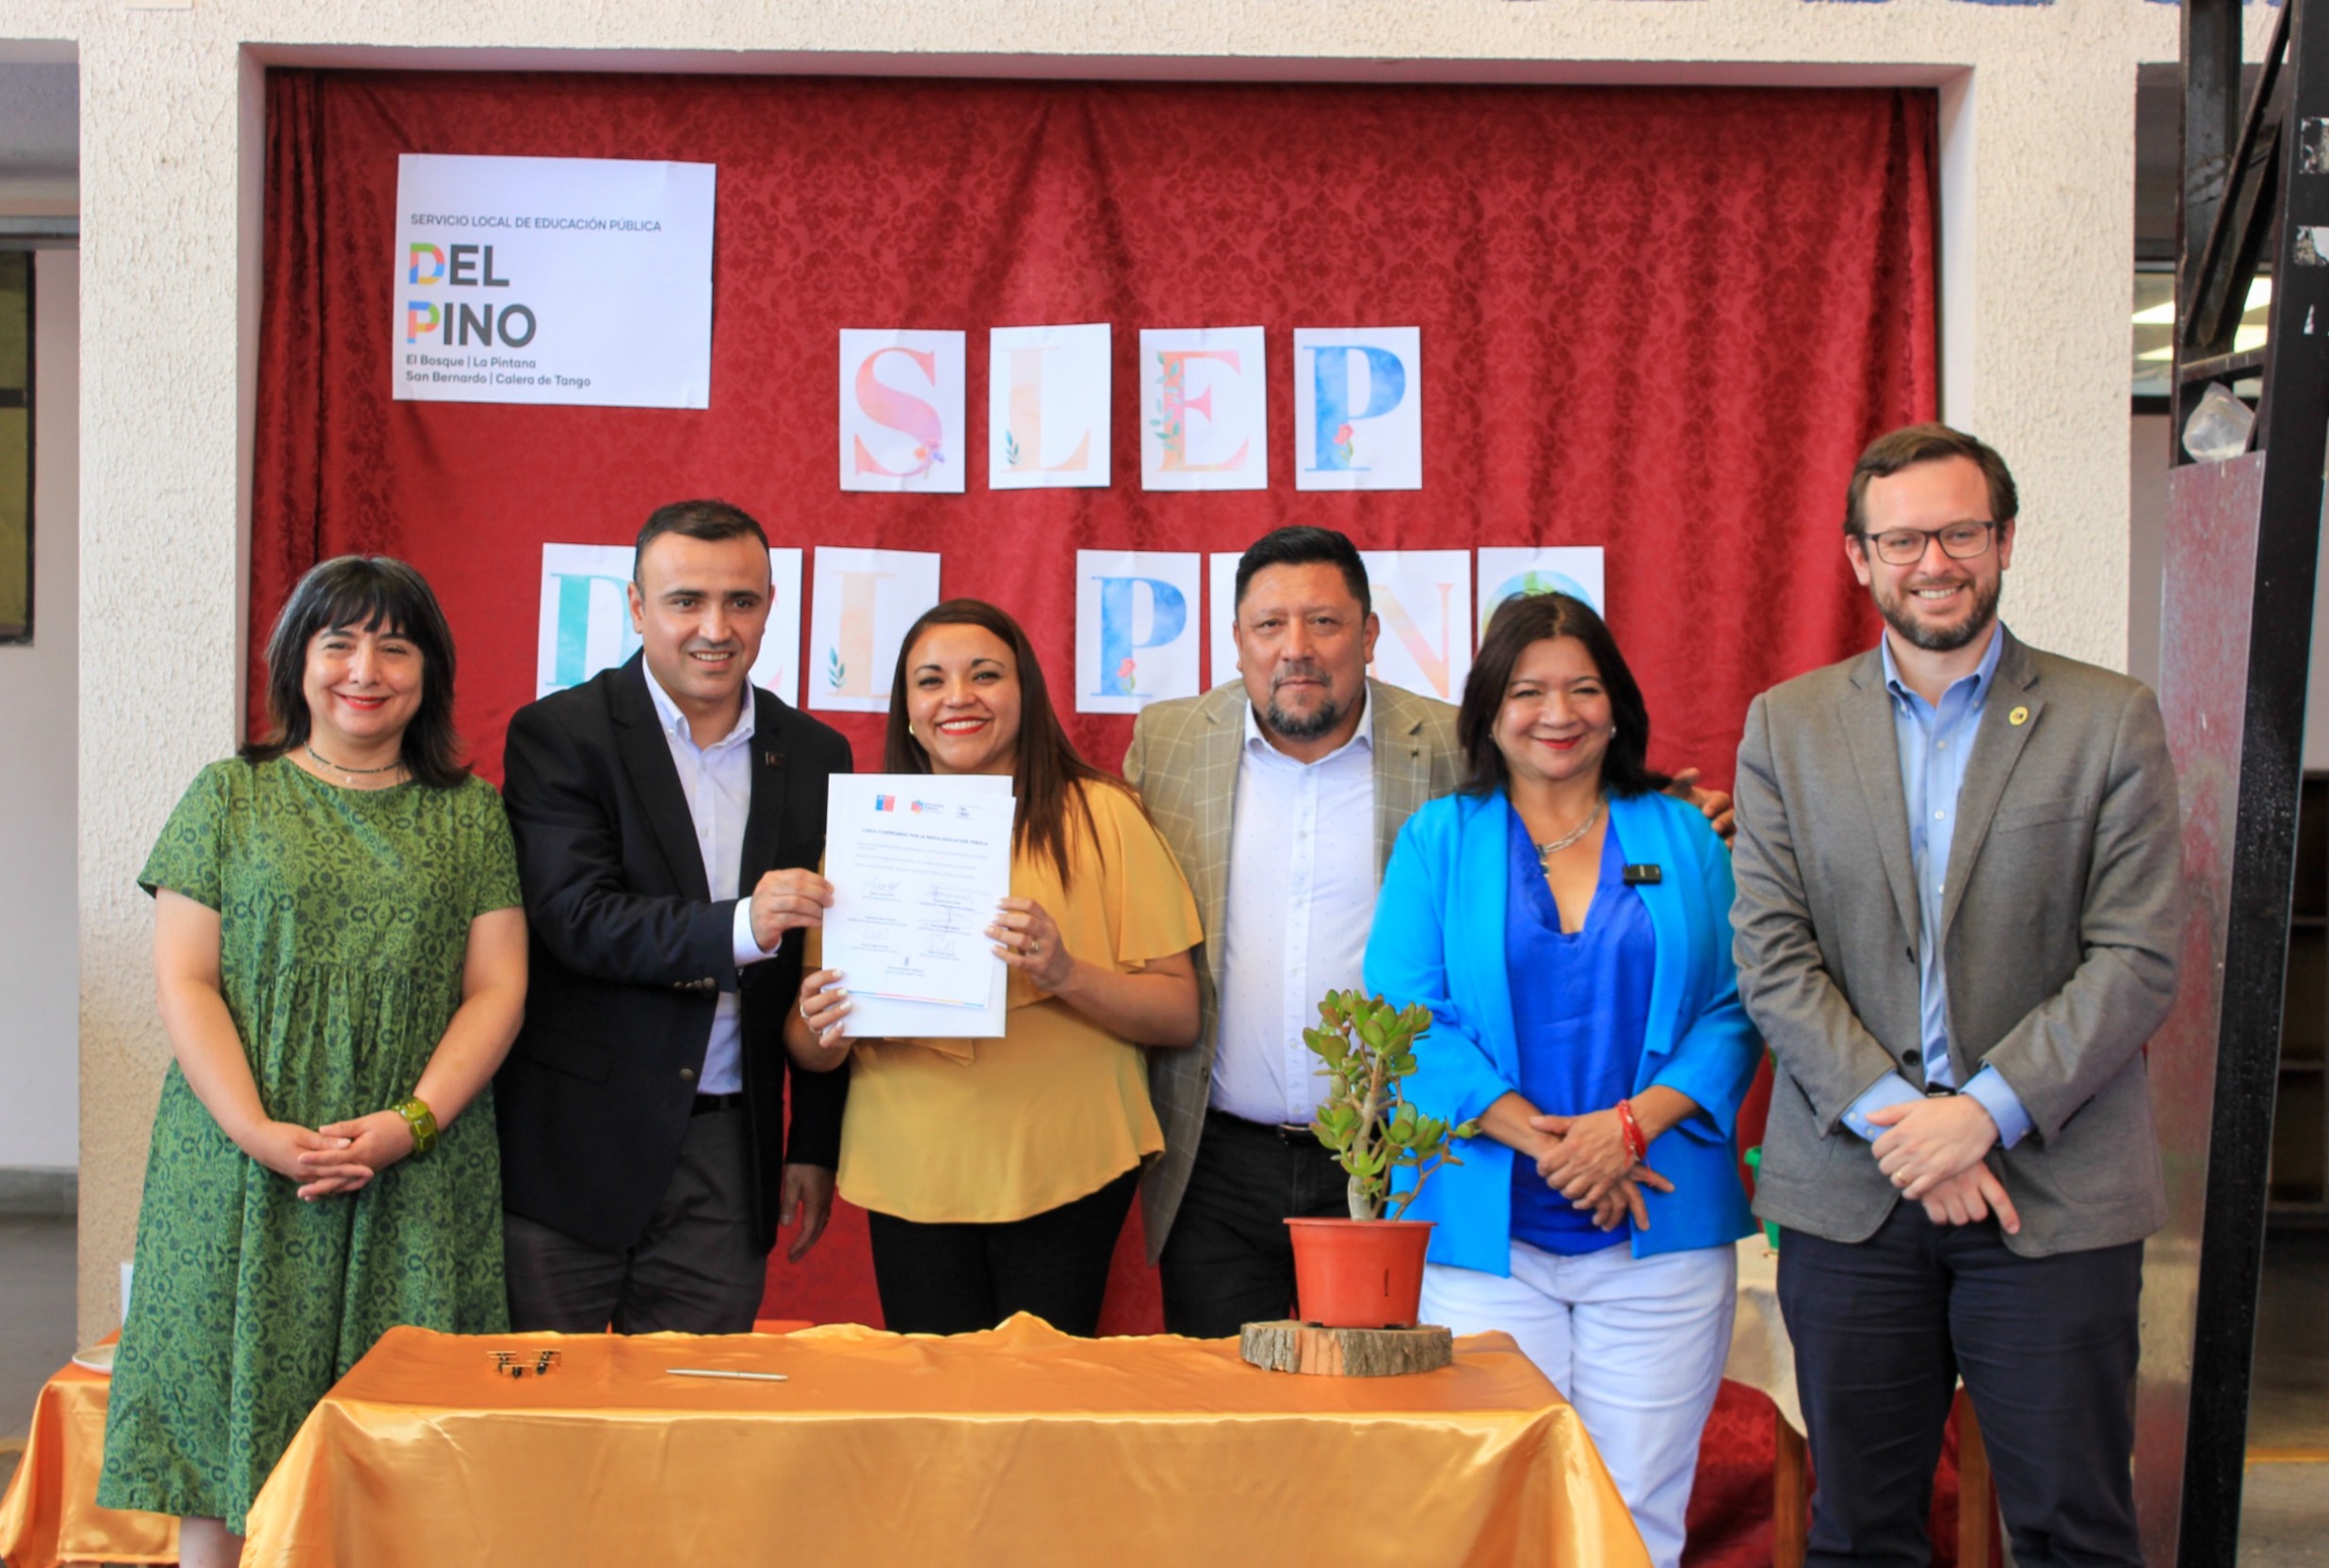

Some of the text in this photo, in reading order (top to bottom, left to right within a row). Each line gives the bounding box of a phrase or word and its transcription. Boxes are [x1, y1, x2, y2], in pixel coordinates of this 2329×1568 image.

[411, 213, 662, 232] SERVICIO LOCAL DE EDUCACIÓN PÚBLICA
[409, 242, 509, 287] DEL
[407, 300, 537, 348] PINO
[406, 354, 417, 365] El
[420, 355, 464, 368] Bosque
[474, 356, 487, 367] La
[491, 356, 536, 368] Pintana
[406, 370, 429, 381] San
[432, 371, 487, 384] Bernardo
[496, 373, 535, 385] Calera
[538, 374, 552, 385] de
[555, 375, 591, 389] Tango
[854, 345, 1406, 477] SLEP
